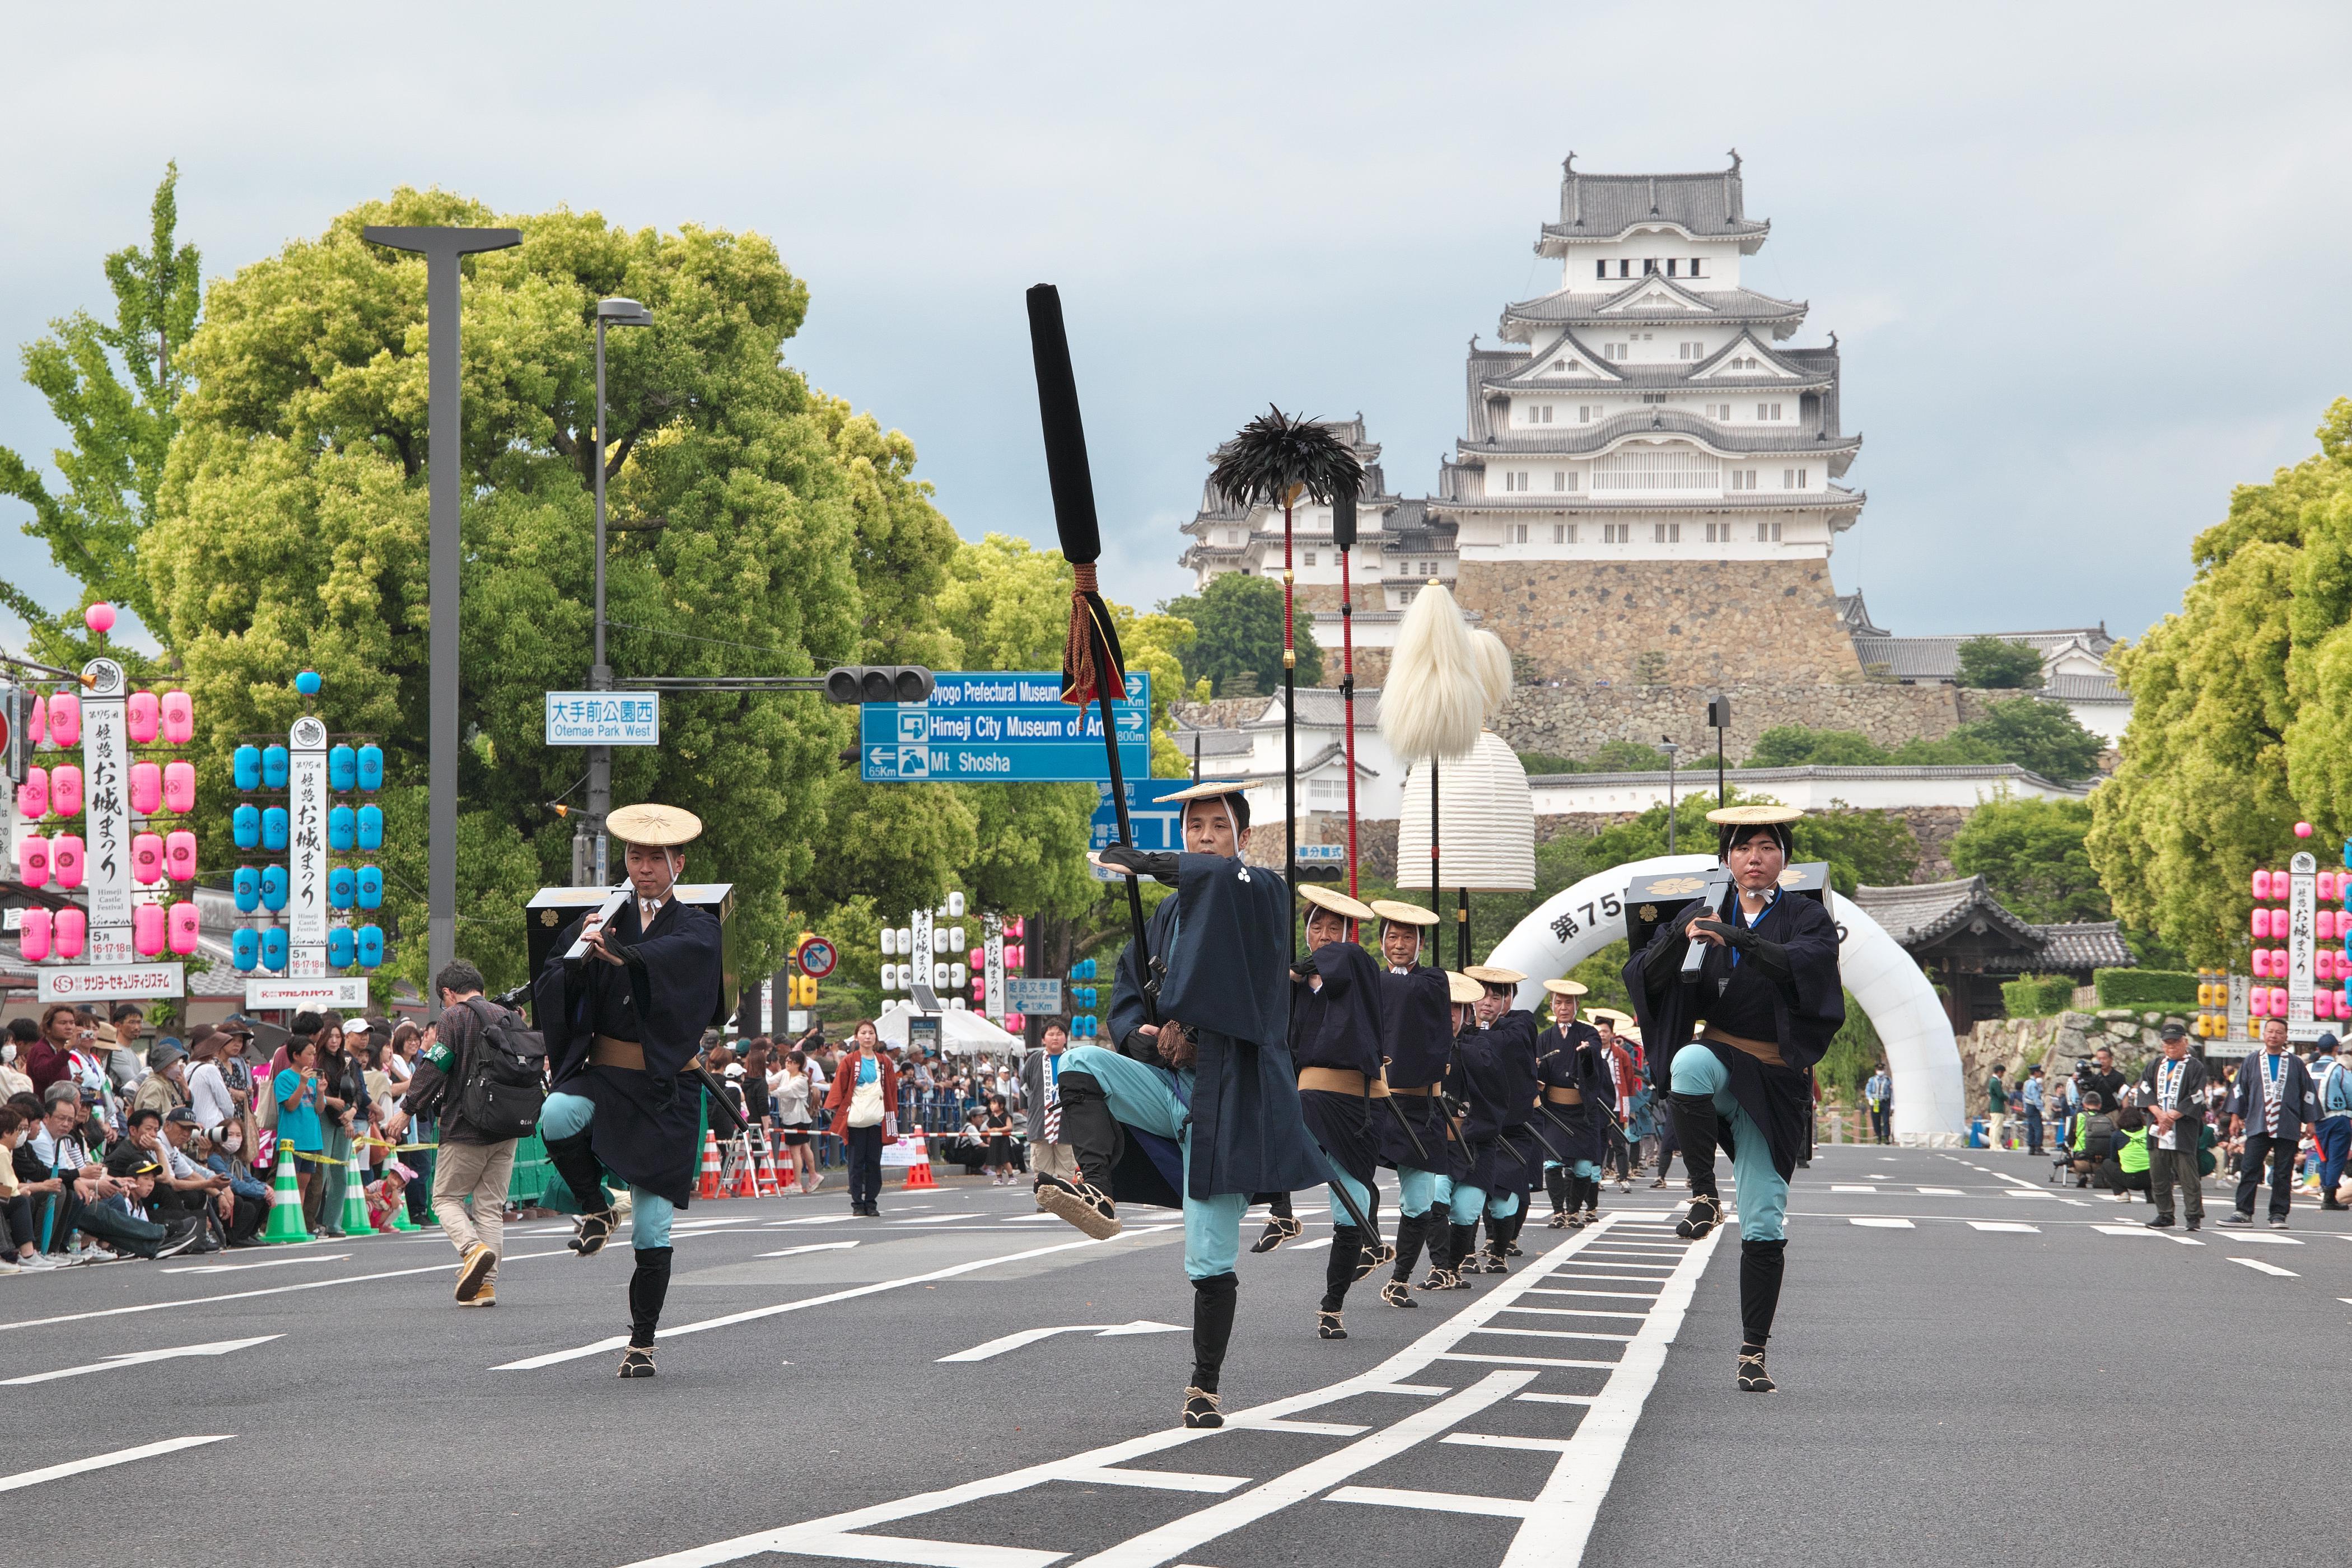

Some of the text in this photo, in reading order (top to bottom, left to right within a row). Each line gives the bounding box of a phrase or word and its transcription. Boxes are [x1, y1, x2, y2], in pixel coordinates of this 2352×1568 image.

[930, 681, 1060, 706] Hyogo Prefectural Museum
[552, 701, 653, 722] 大手前公園西
[555, 725, 650, 736] Otemae Park West
[930, 716, 970, 741] Himeji
[976, 716, 1001, 741] City
[1007, 716, 1061, 736] Museum
[1067, 716, 1081, 736] of
[959, 752, 1010, 772] Shosha
[92, 723, 122, 884] 姫路お城まつり
[296, 773, 321, 909] 姫路お城まつり
[1095, 824, 1138, 838] 書写山
[1550, 888, 1628, 944] 第75
[93, 931, 110, 941] 5月
[2294, 888, 2311, 976] 姫路お城まつり
[293, 950, 307, 958] 5月
[1009, 982, 1058, 993] 姫路文学館
